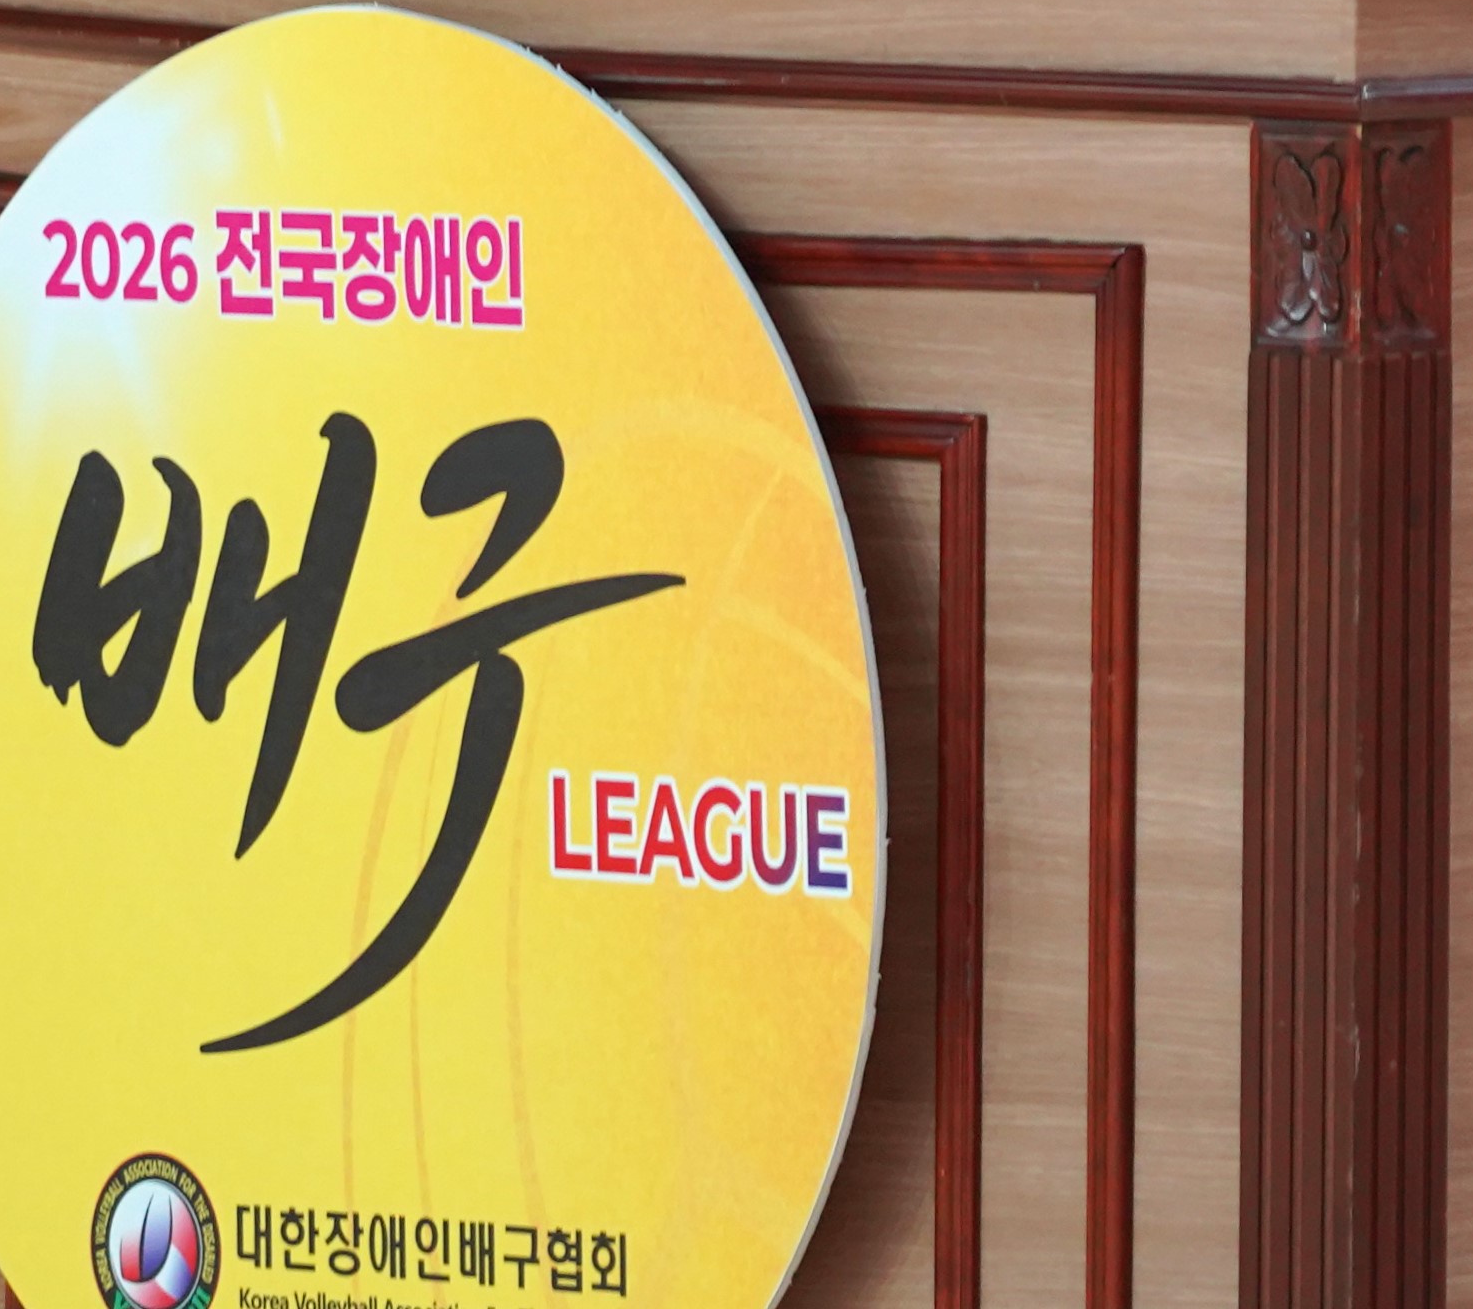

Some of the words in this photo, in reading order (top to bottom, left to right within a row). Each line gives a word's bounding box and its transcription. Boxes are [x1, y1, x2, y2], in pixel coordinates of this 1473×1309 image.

[43, 219, 198, 303] 2026
[214, 210, 524, 327] 전국장애인
[33, 412, 687, 1053] 배구
[552, 776, 848, 889] LEAGUE
[124, 1158, 178, 1183] ASSOCIATION
[179, 1172, 197, 1199] FOR
[194, 1193, 210, 1222] THE
[236, 1204, 627, 1296] 대한장애인배구협회
[239, 1287, 289, 1309] Korea
